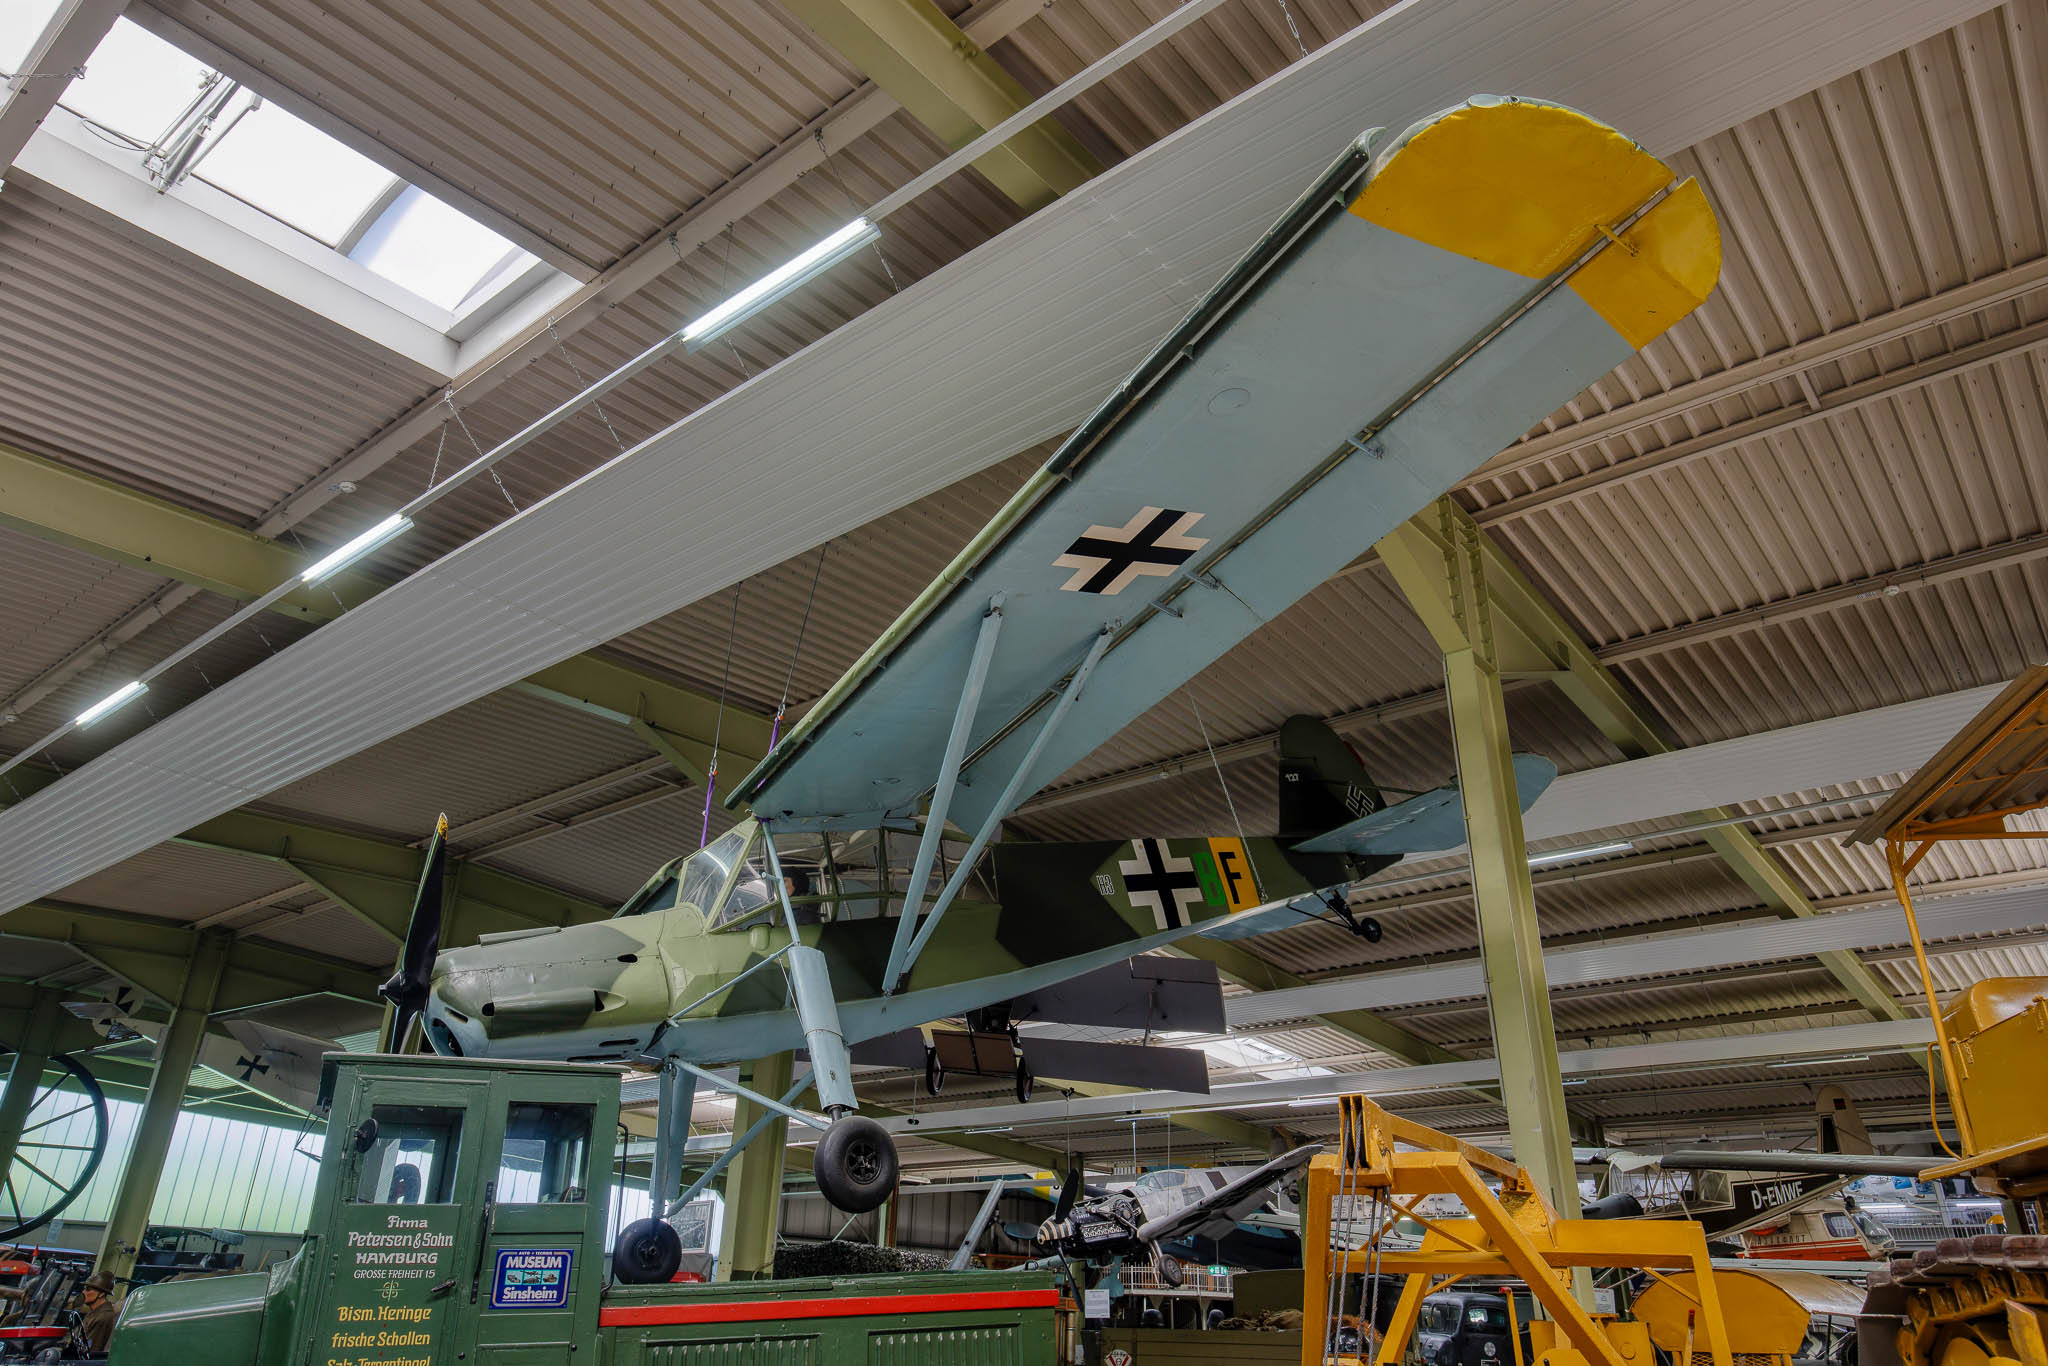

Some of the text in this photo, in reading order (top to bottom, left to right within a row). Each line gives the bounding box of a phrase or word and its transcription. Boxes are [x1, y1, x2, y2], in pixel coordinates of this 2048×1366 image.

[1096, 874, 1115, 896] H3
[387, 1215, 428, 1229] Firma
[347, 1231, 412, 1248] Petersen
[422, 1232, 453, 1247] Sohn
[355, 1252, 438, 1265] HAMBURG
[505, 1256, 562, 1269] MUSEUM
[353, 1269, 436, 1279] GROSSE FREIHEIT 15
[502, 1286, 557, 1300] Sinsheim
[337, 1306, 432, 1323] Bism. Heringe
[331, 1331, 430, 1349] frische Schollen
